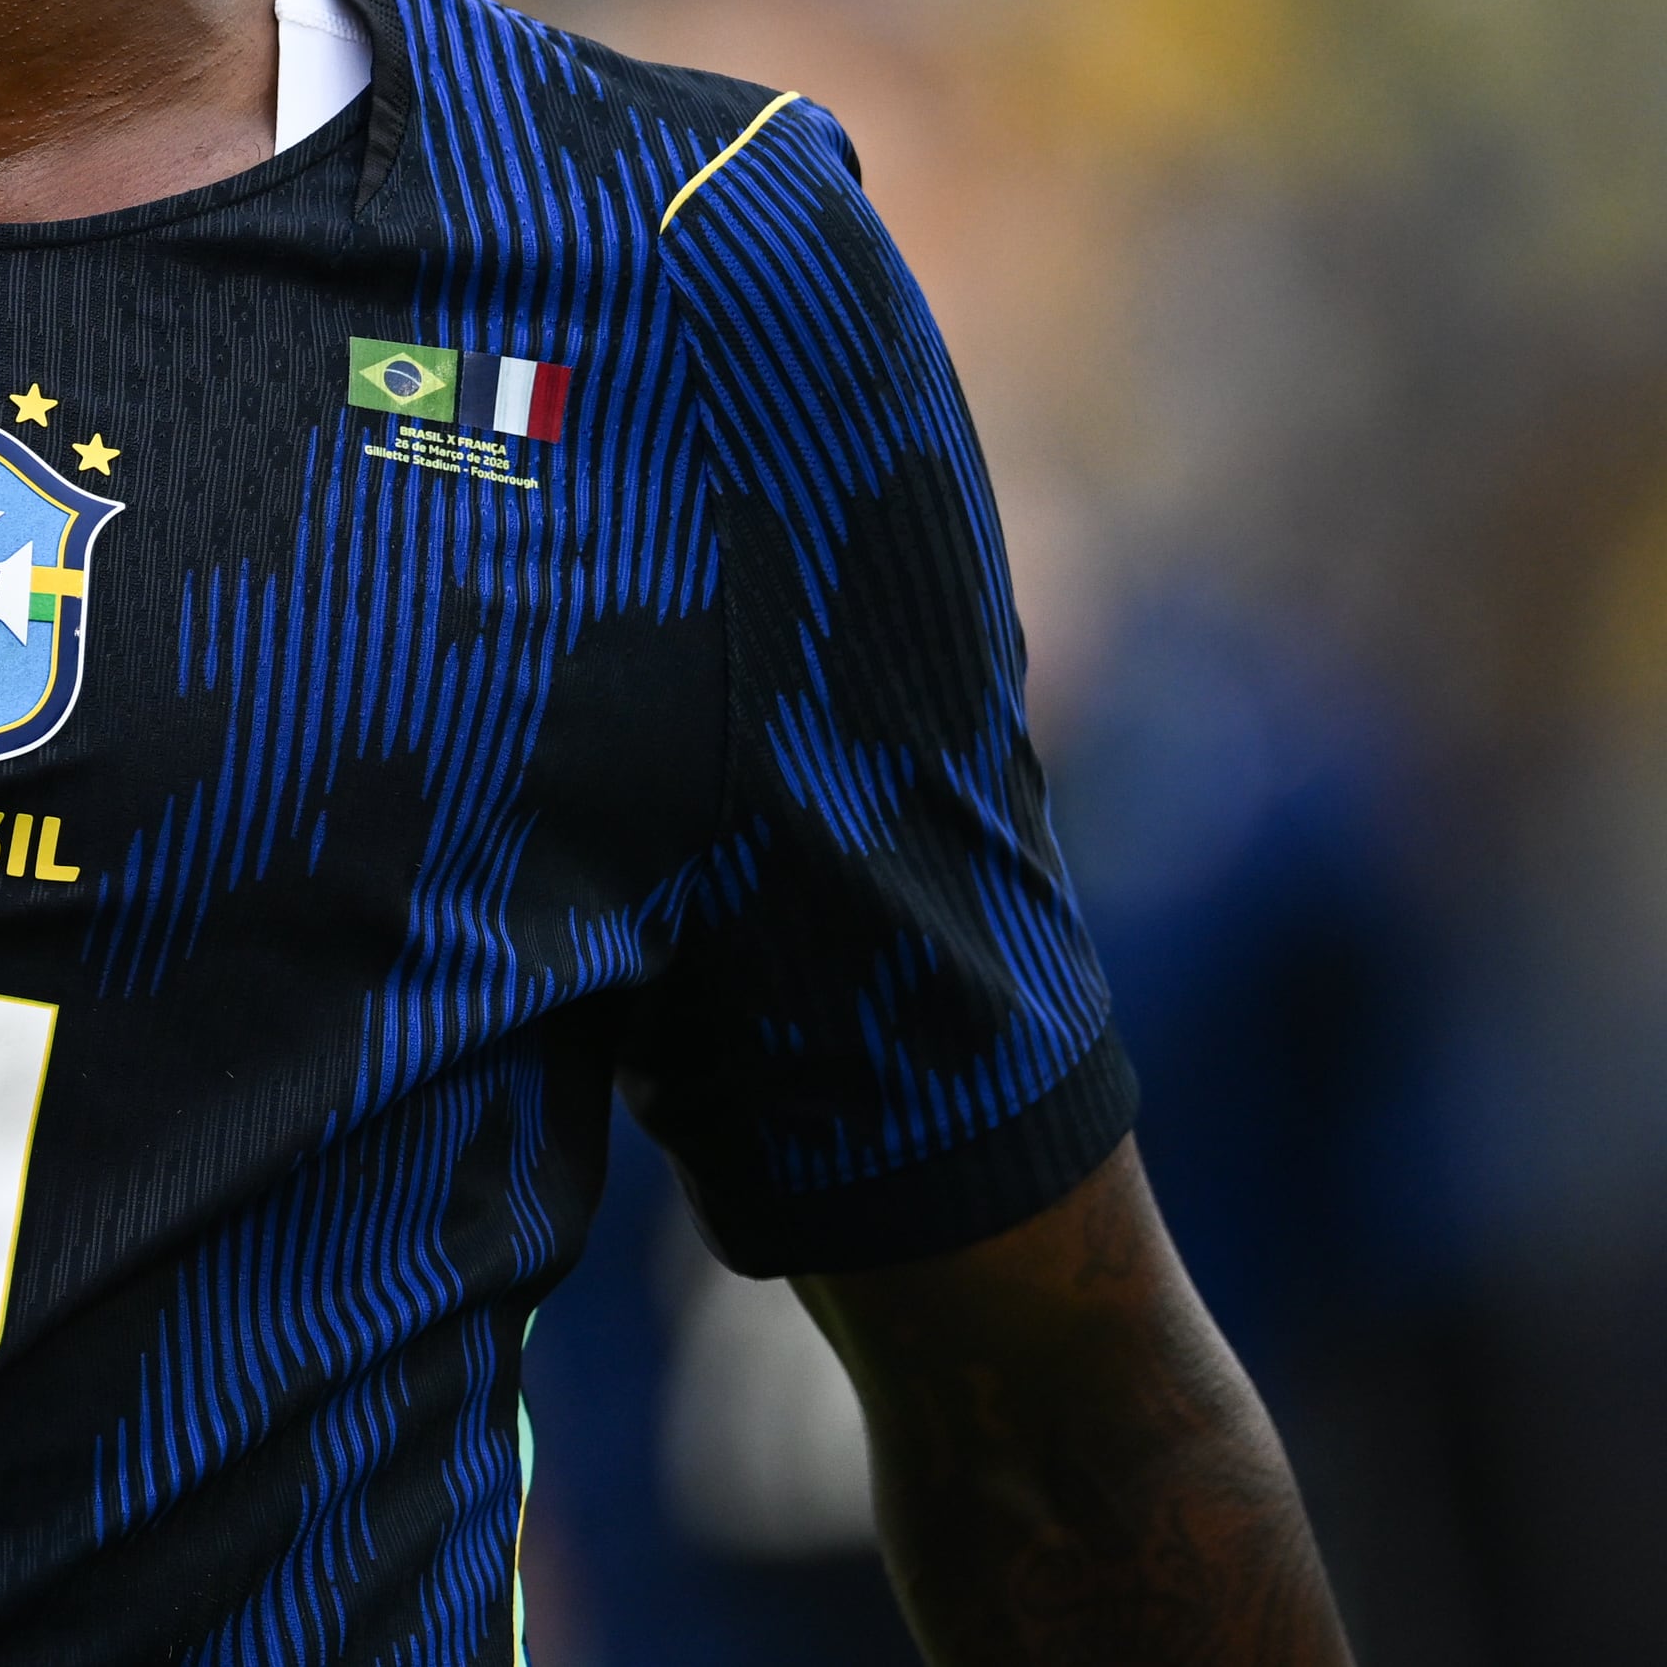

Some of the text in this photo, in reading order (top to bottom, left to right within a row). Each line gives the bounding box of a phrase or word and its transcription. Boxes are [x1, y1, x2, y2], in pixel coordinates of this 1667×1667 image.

[394, 437, 510, 470] 26 de Março de 2026
[399, 426, 506, 456] BRASIL X FRANÇA
[412, 454, 461, 473] Stadium
[470, 465, 539, 489] Foxborough
